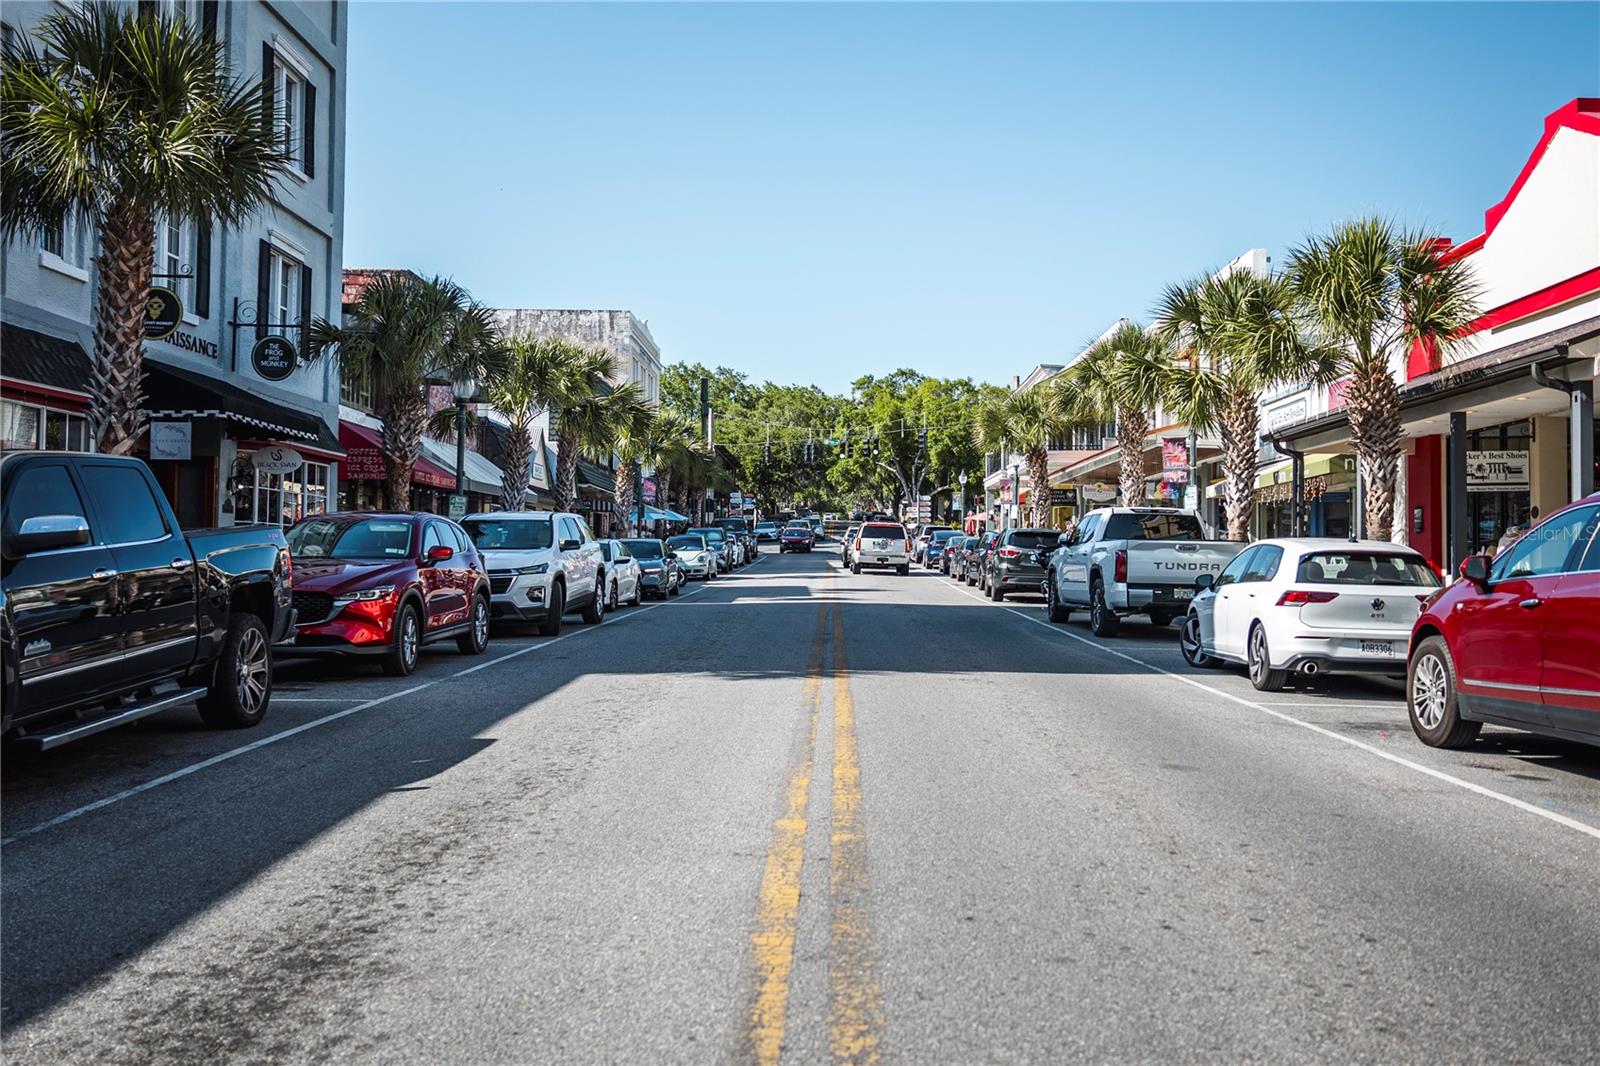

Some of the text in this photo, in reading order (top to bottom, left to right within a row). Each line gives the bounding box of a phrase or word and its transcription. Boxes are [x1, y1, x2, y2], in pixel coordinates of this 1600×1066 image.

[162, 331, 218, 359] AISSANCE
[264, 349, 284, 357] FROG
[260, 360, 289, 368] MONKEY
[1505, 451, 1528, 459] Shoes
[347, 456, 383, 464] ESPRESS
[363, 464, 386, 472] CREA
[347, 472, 389, 480] SANDWIC
[1153, 562, 1220, 571] TUNDRA
